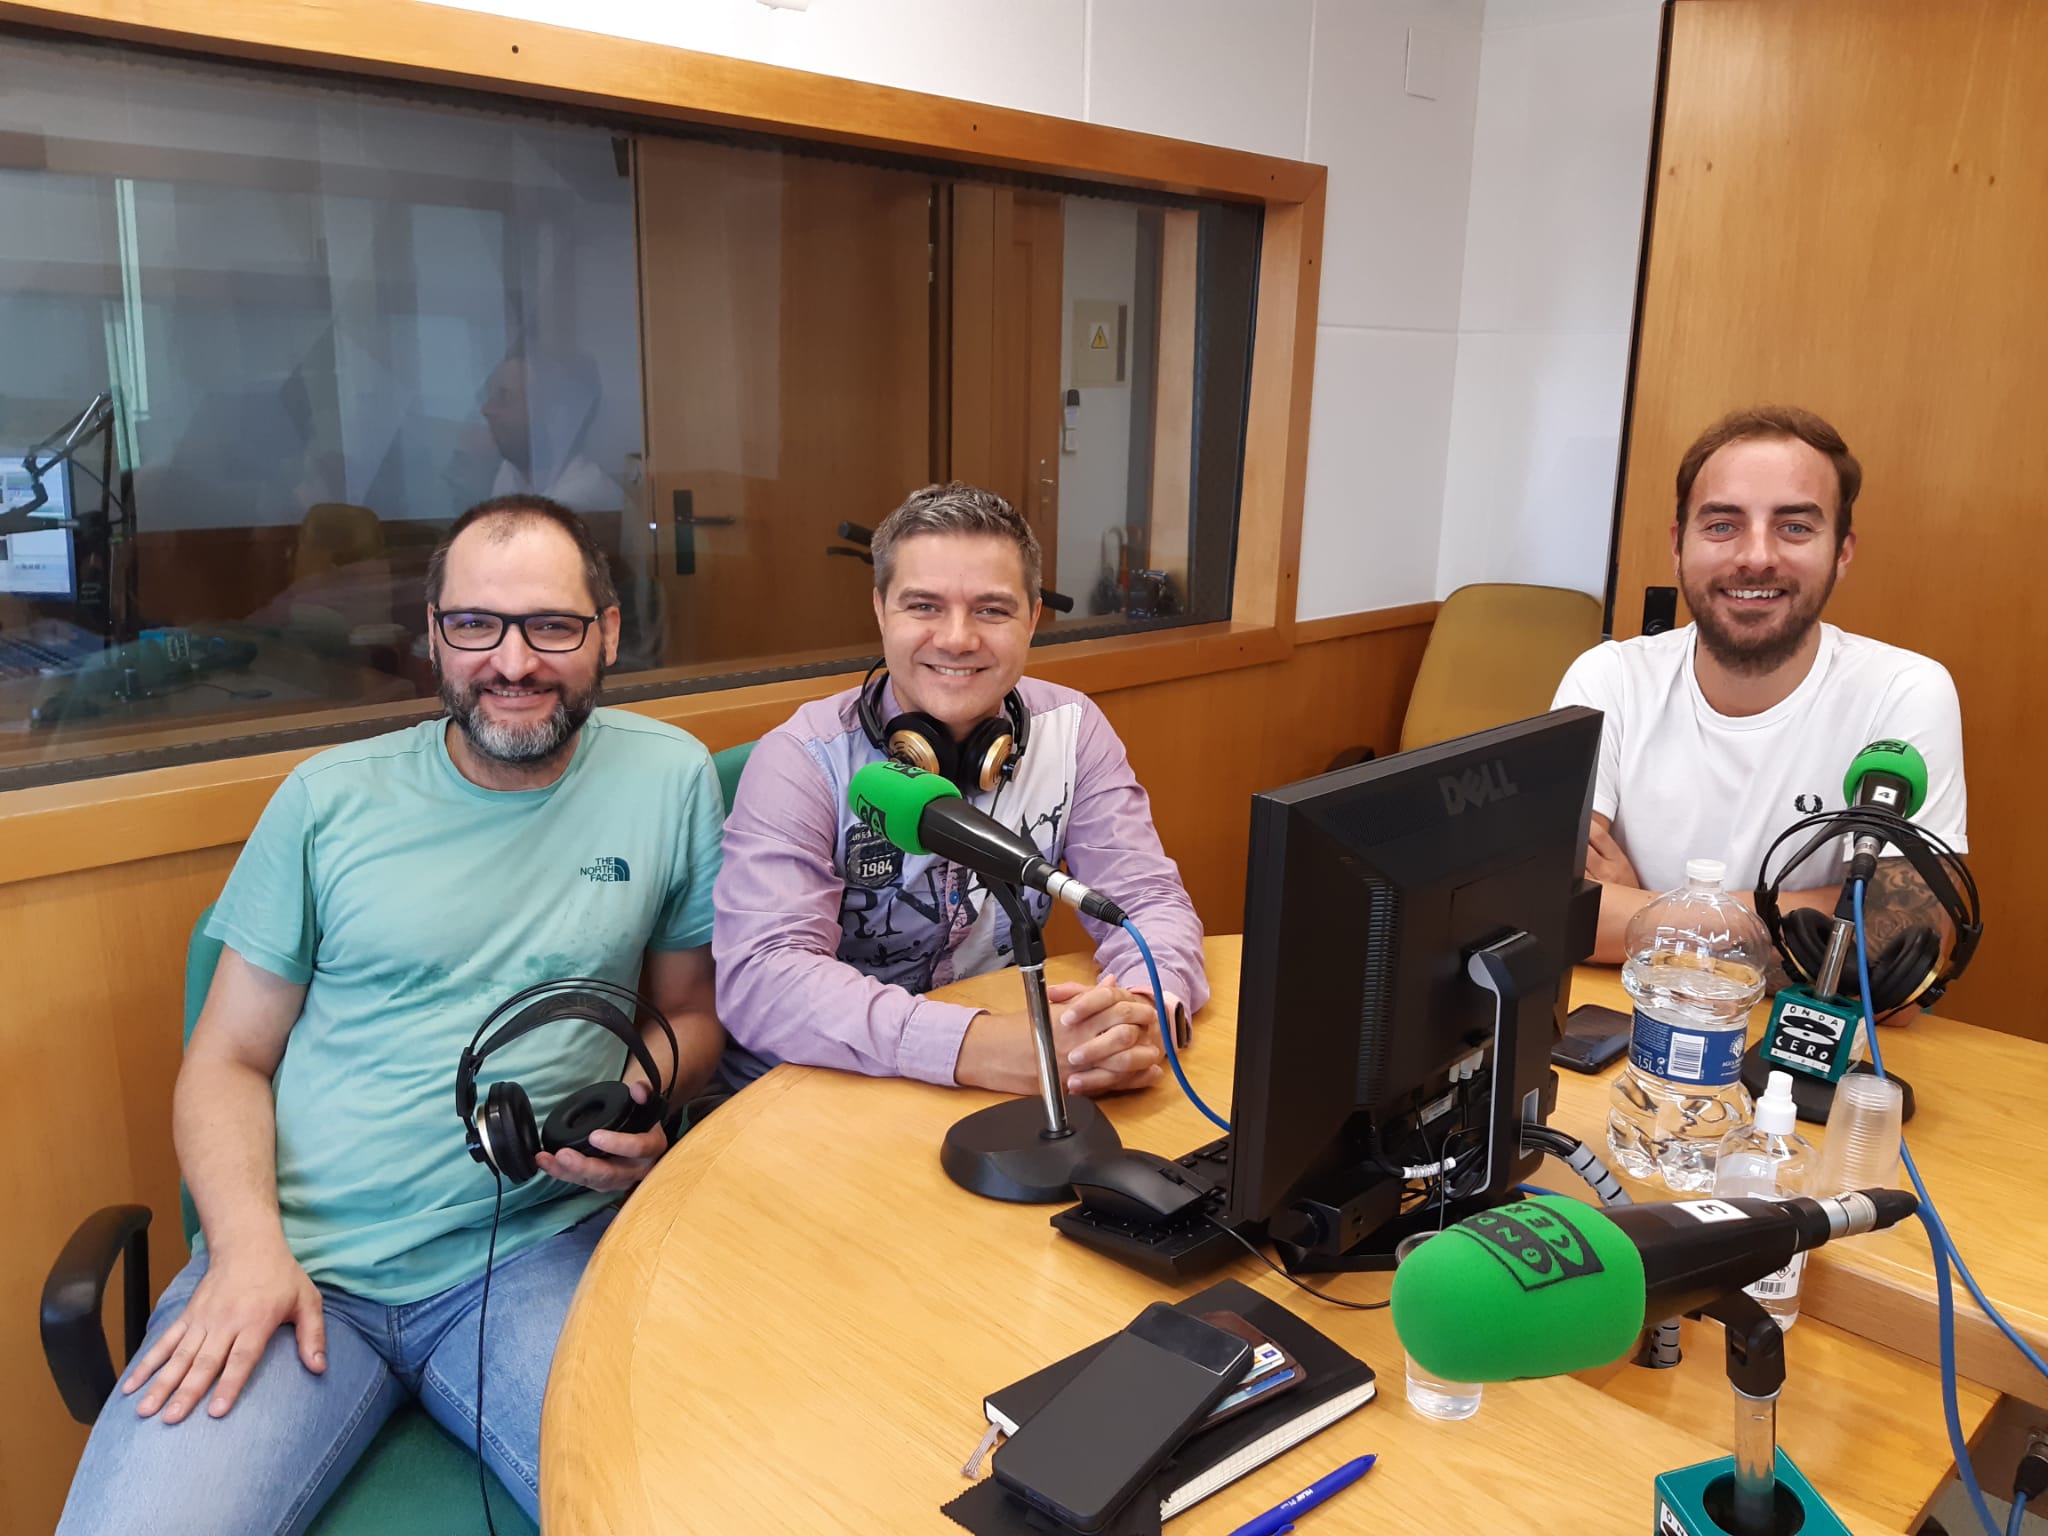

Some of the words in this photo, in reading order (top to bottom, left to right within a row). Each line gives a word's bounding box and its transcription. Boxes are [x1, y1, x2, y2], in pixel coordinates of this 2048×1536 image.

[1438, 759, 1518, 816] DELL
[580, 865, 614, 876] NORTH
[595, 857, 614, 866] THE
[861, 859, 893, 878] 1984
[590, 873, 614, 882] FACE
[1789, 1005, 1839, 1026] ONDA
[1775, 1035, 1829, 1060] CERO
[1699, 1203, 1728, 1216] 3
[1503, 1204, 1572, 1250] CER
[1478, 1216, 1542, 1264] OND
